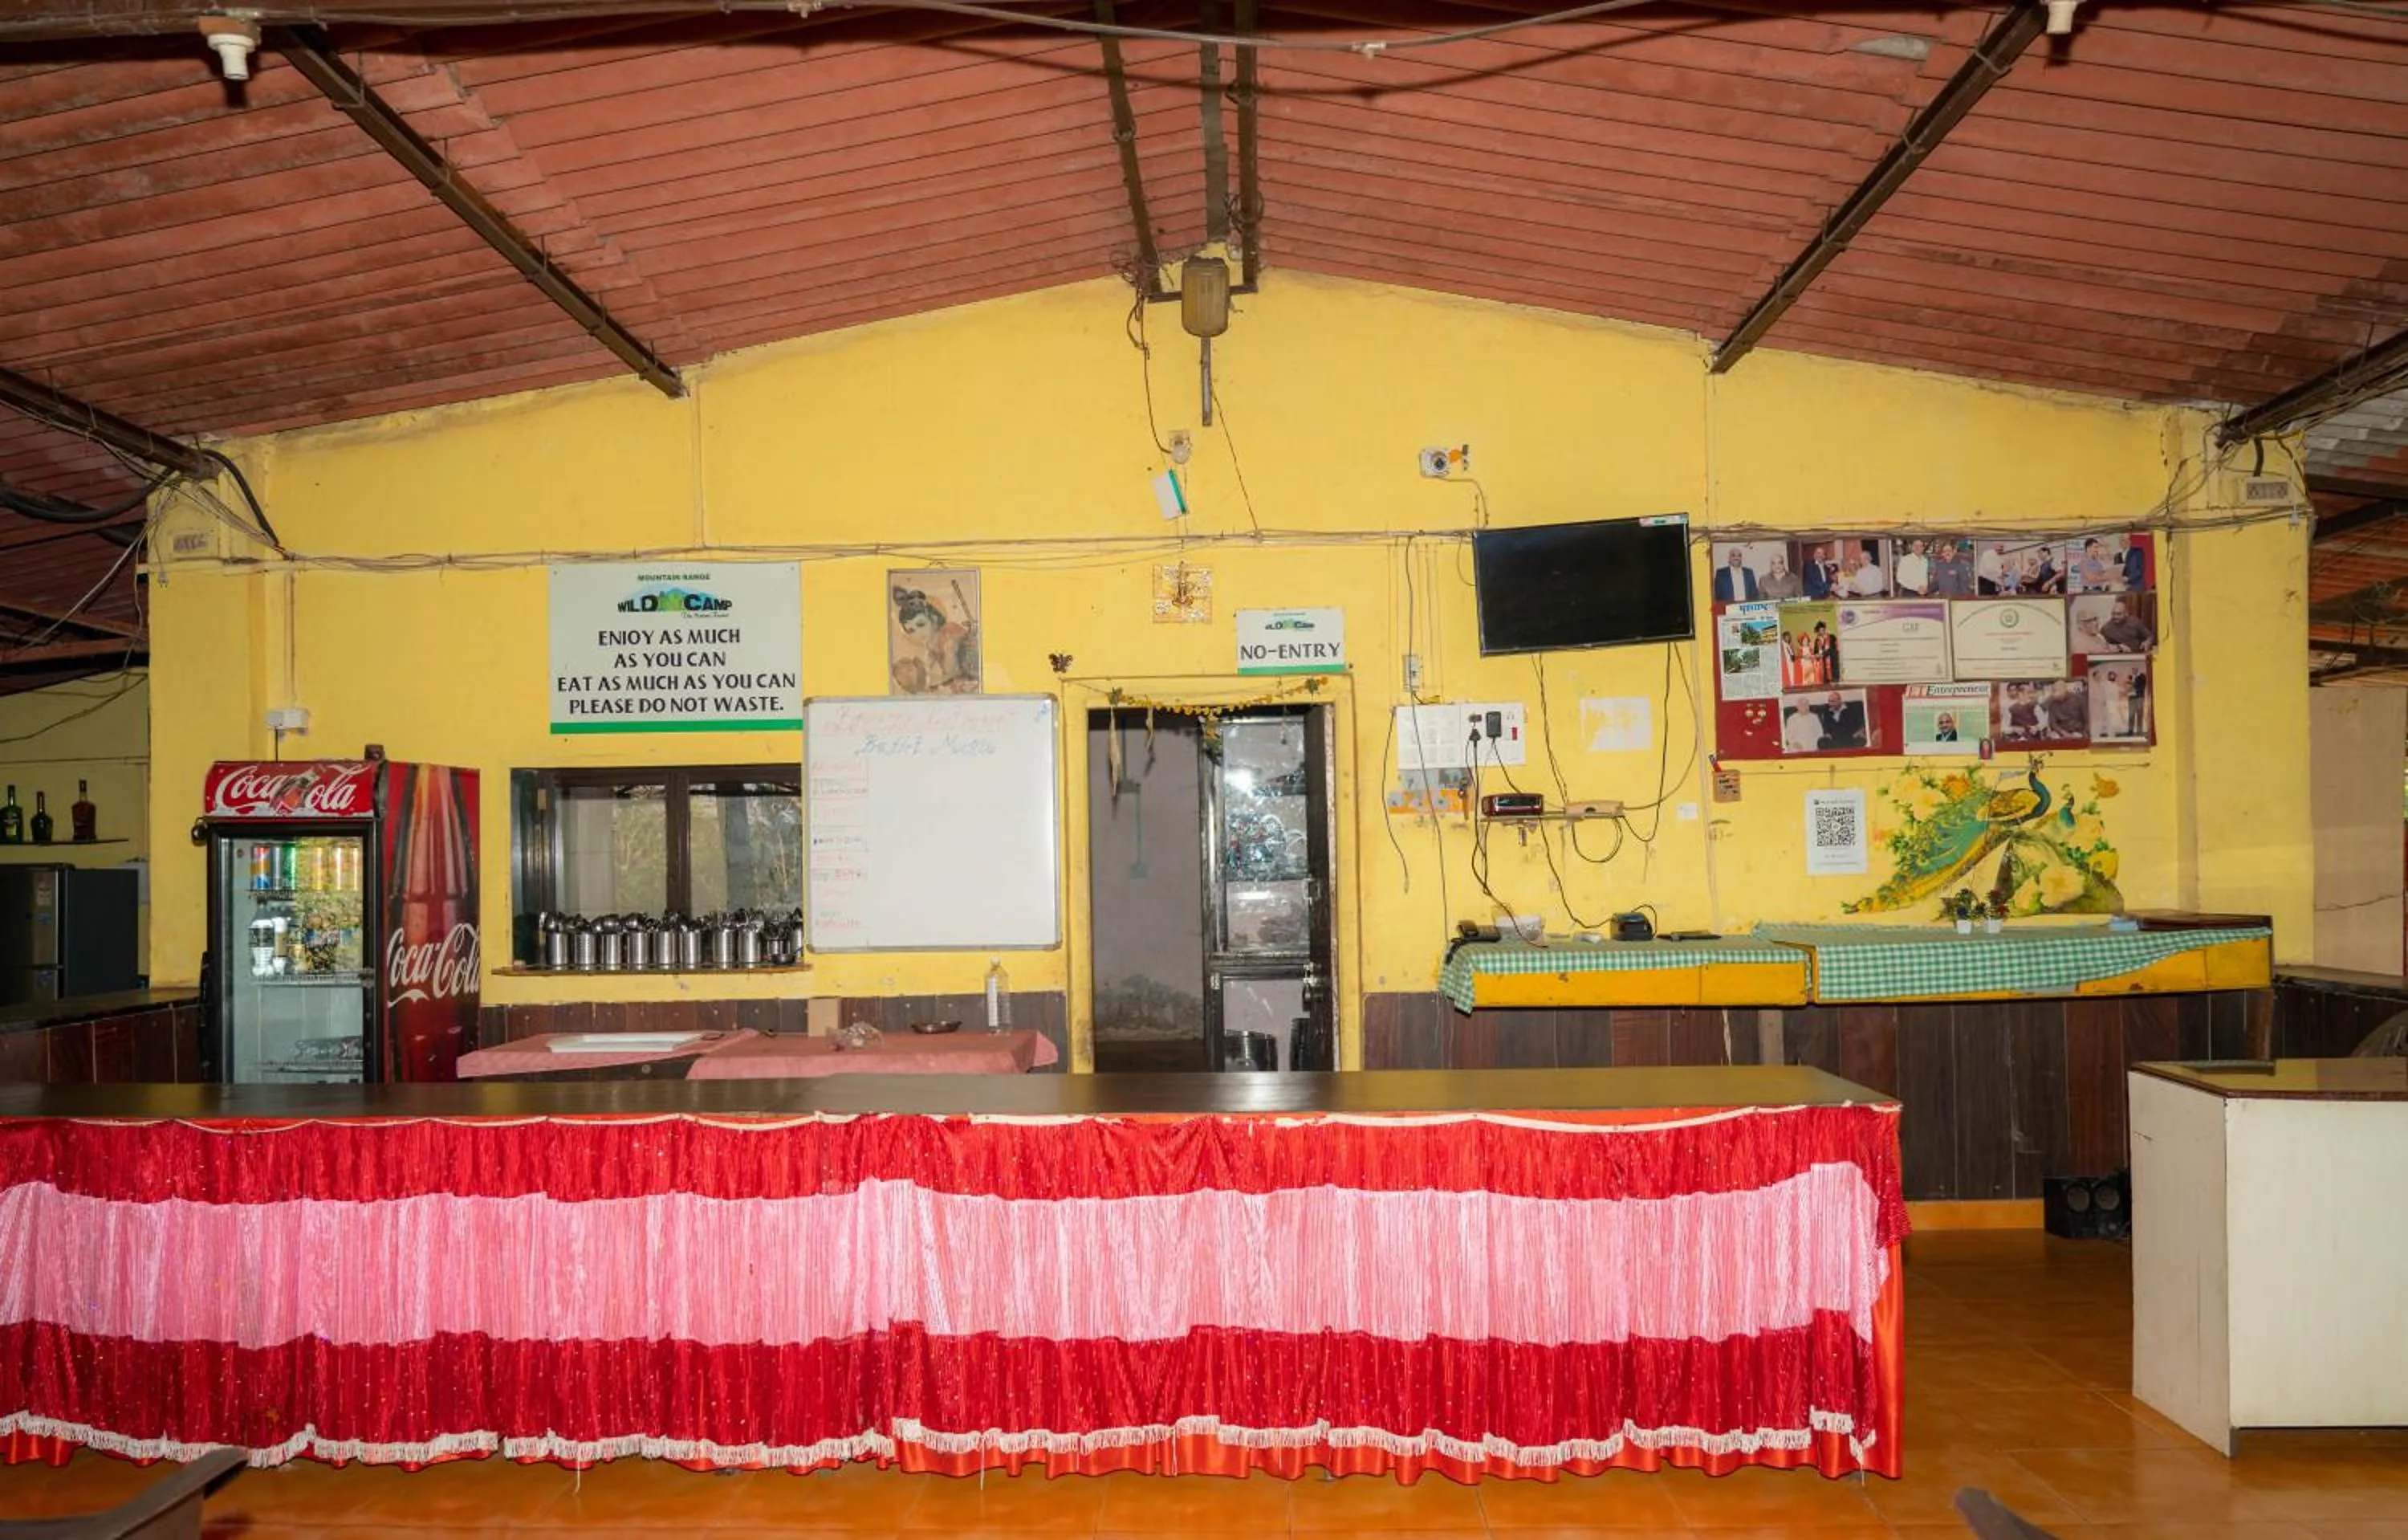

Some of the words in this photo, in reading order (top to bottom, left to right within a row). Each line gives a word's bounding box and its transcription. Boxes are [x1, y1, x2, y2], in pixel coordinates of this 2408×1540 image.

[617, 594, 658, 613] WILD
[684, 593, 733, 611] CAMP
[659, 629, 683, 645] AS
[687, 628, 740, 644] MUCH
[614, 652, 638, 668] AS
[642, 651, 682, 667] YOU
[686, 650, 726, 667] CAN
[1240, 642, 1341, 660] NO-ENTRY
[557, 676, 592, 691] EAT
[597, 675, 621, 691] AS
[625, 674, 679, 691] MUCH
[683, 674, 707, 690] AS
[712, 673, 752, 690] YOU
[756, 672, 795, 689] CAN
[568, 698, 634, 715] PLEASE
[639, 697, 665, 713] DO
[670, 697, 707, 713] NOT
[714, 695, 784, 712] WASTE.
